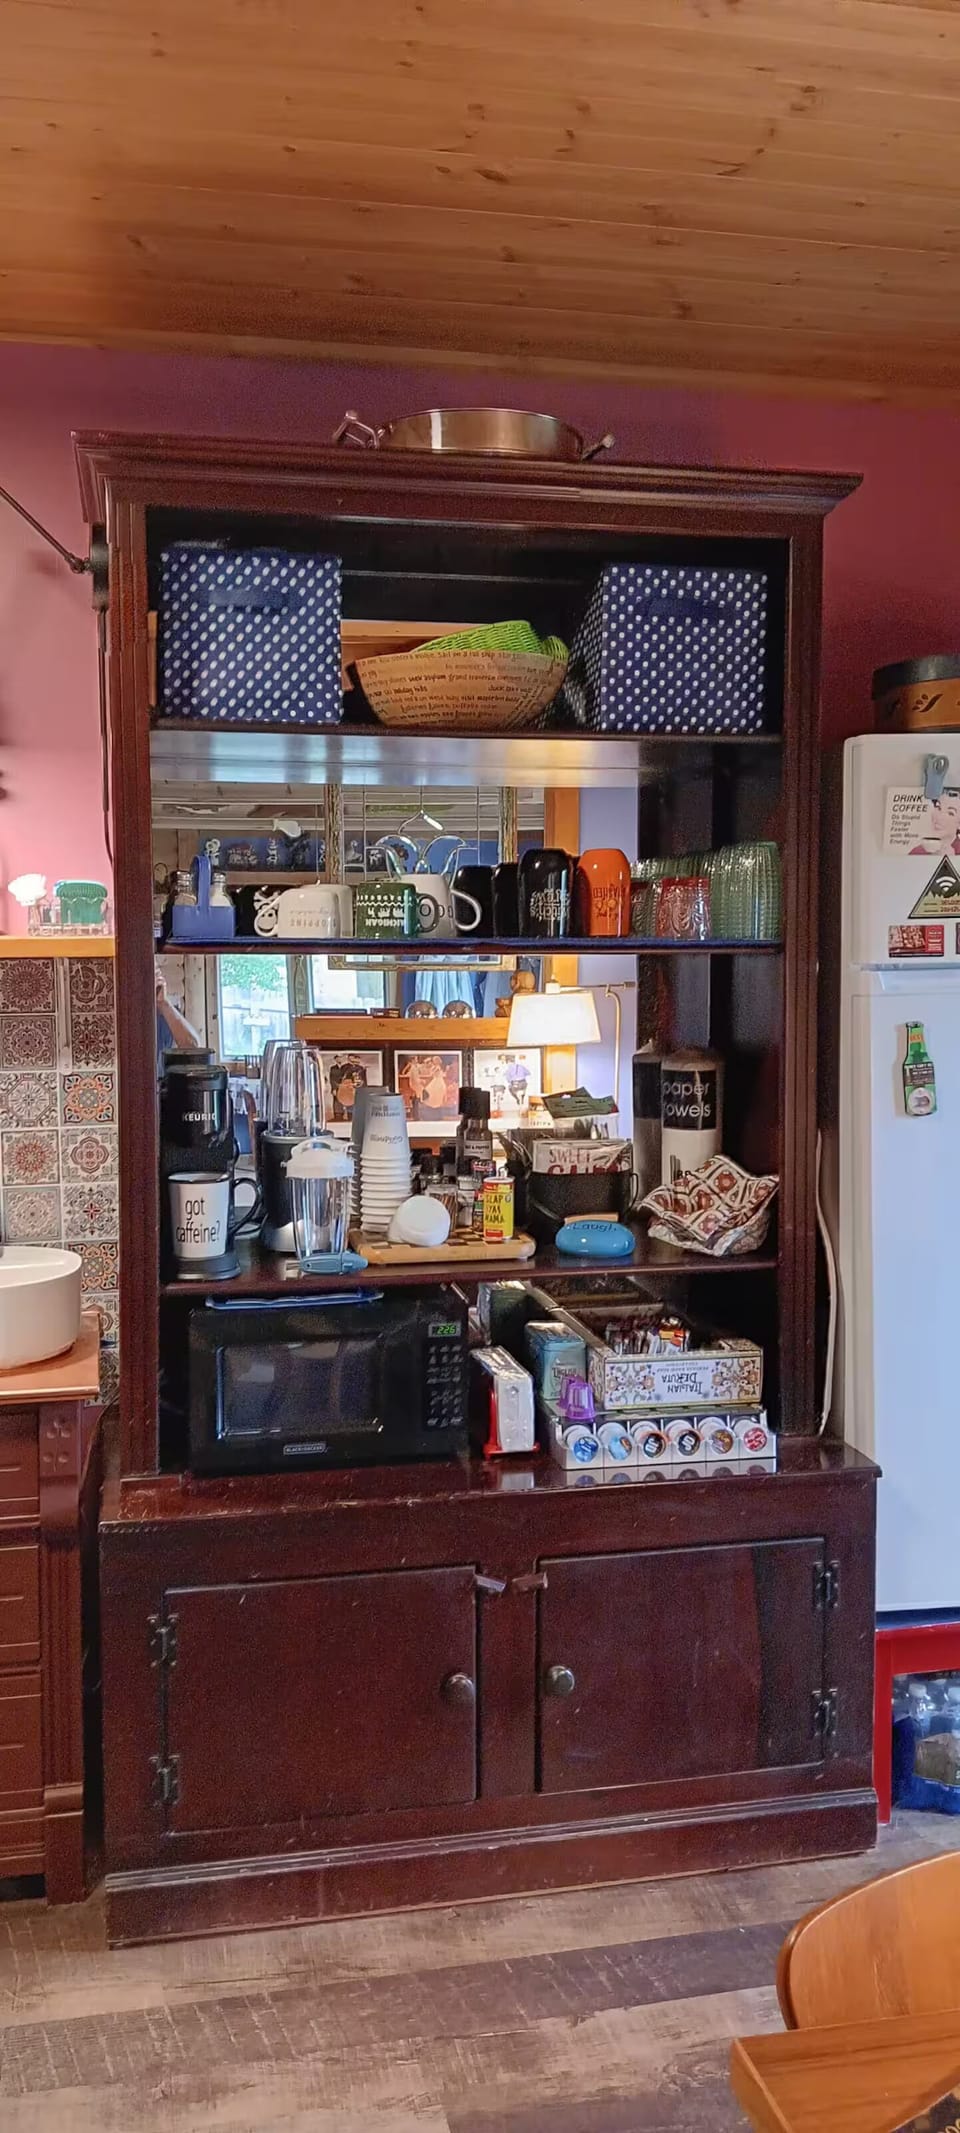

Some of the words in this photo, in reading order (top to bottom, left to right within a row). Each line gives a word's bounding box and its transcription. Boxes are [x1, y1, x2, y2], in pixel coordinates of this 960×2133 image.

[893, 794, 923, 802] DRINK
[892, 804, 928, 812] COFFEE
[662, 1081, 710, 1098] paper
[185, 1196, 206, 1221] got
[175, 1220, 221, 1244] caffeine?
